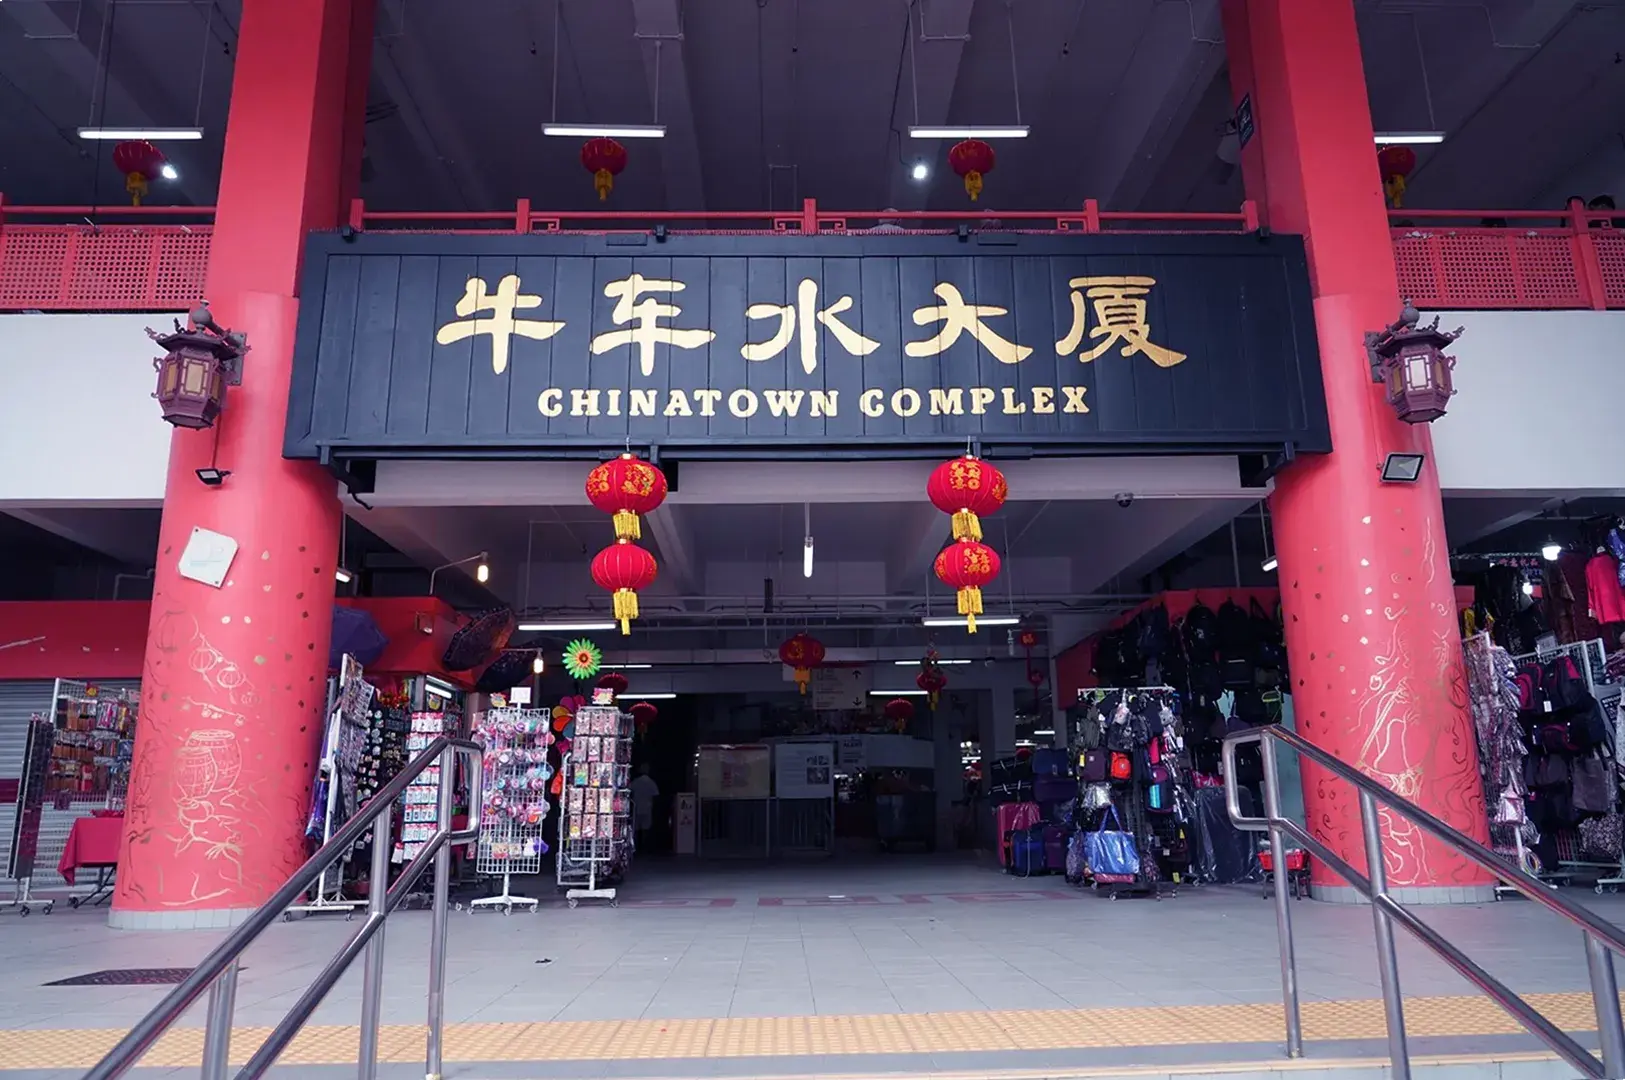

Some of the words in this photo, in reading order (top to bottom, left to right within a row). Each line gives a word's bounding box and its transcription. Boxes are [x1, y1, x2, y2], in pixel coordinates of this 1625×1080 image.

[436, 273, 1187, 374] 牛车水大厦
[537, 387, 839, 418] CHINATOWN
[859, 386, 1090, 417] COMPLEX
